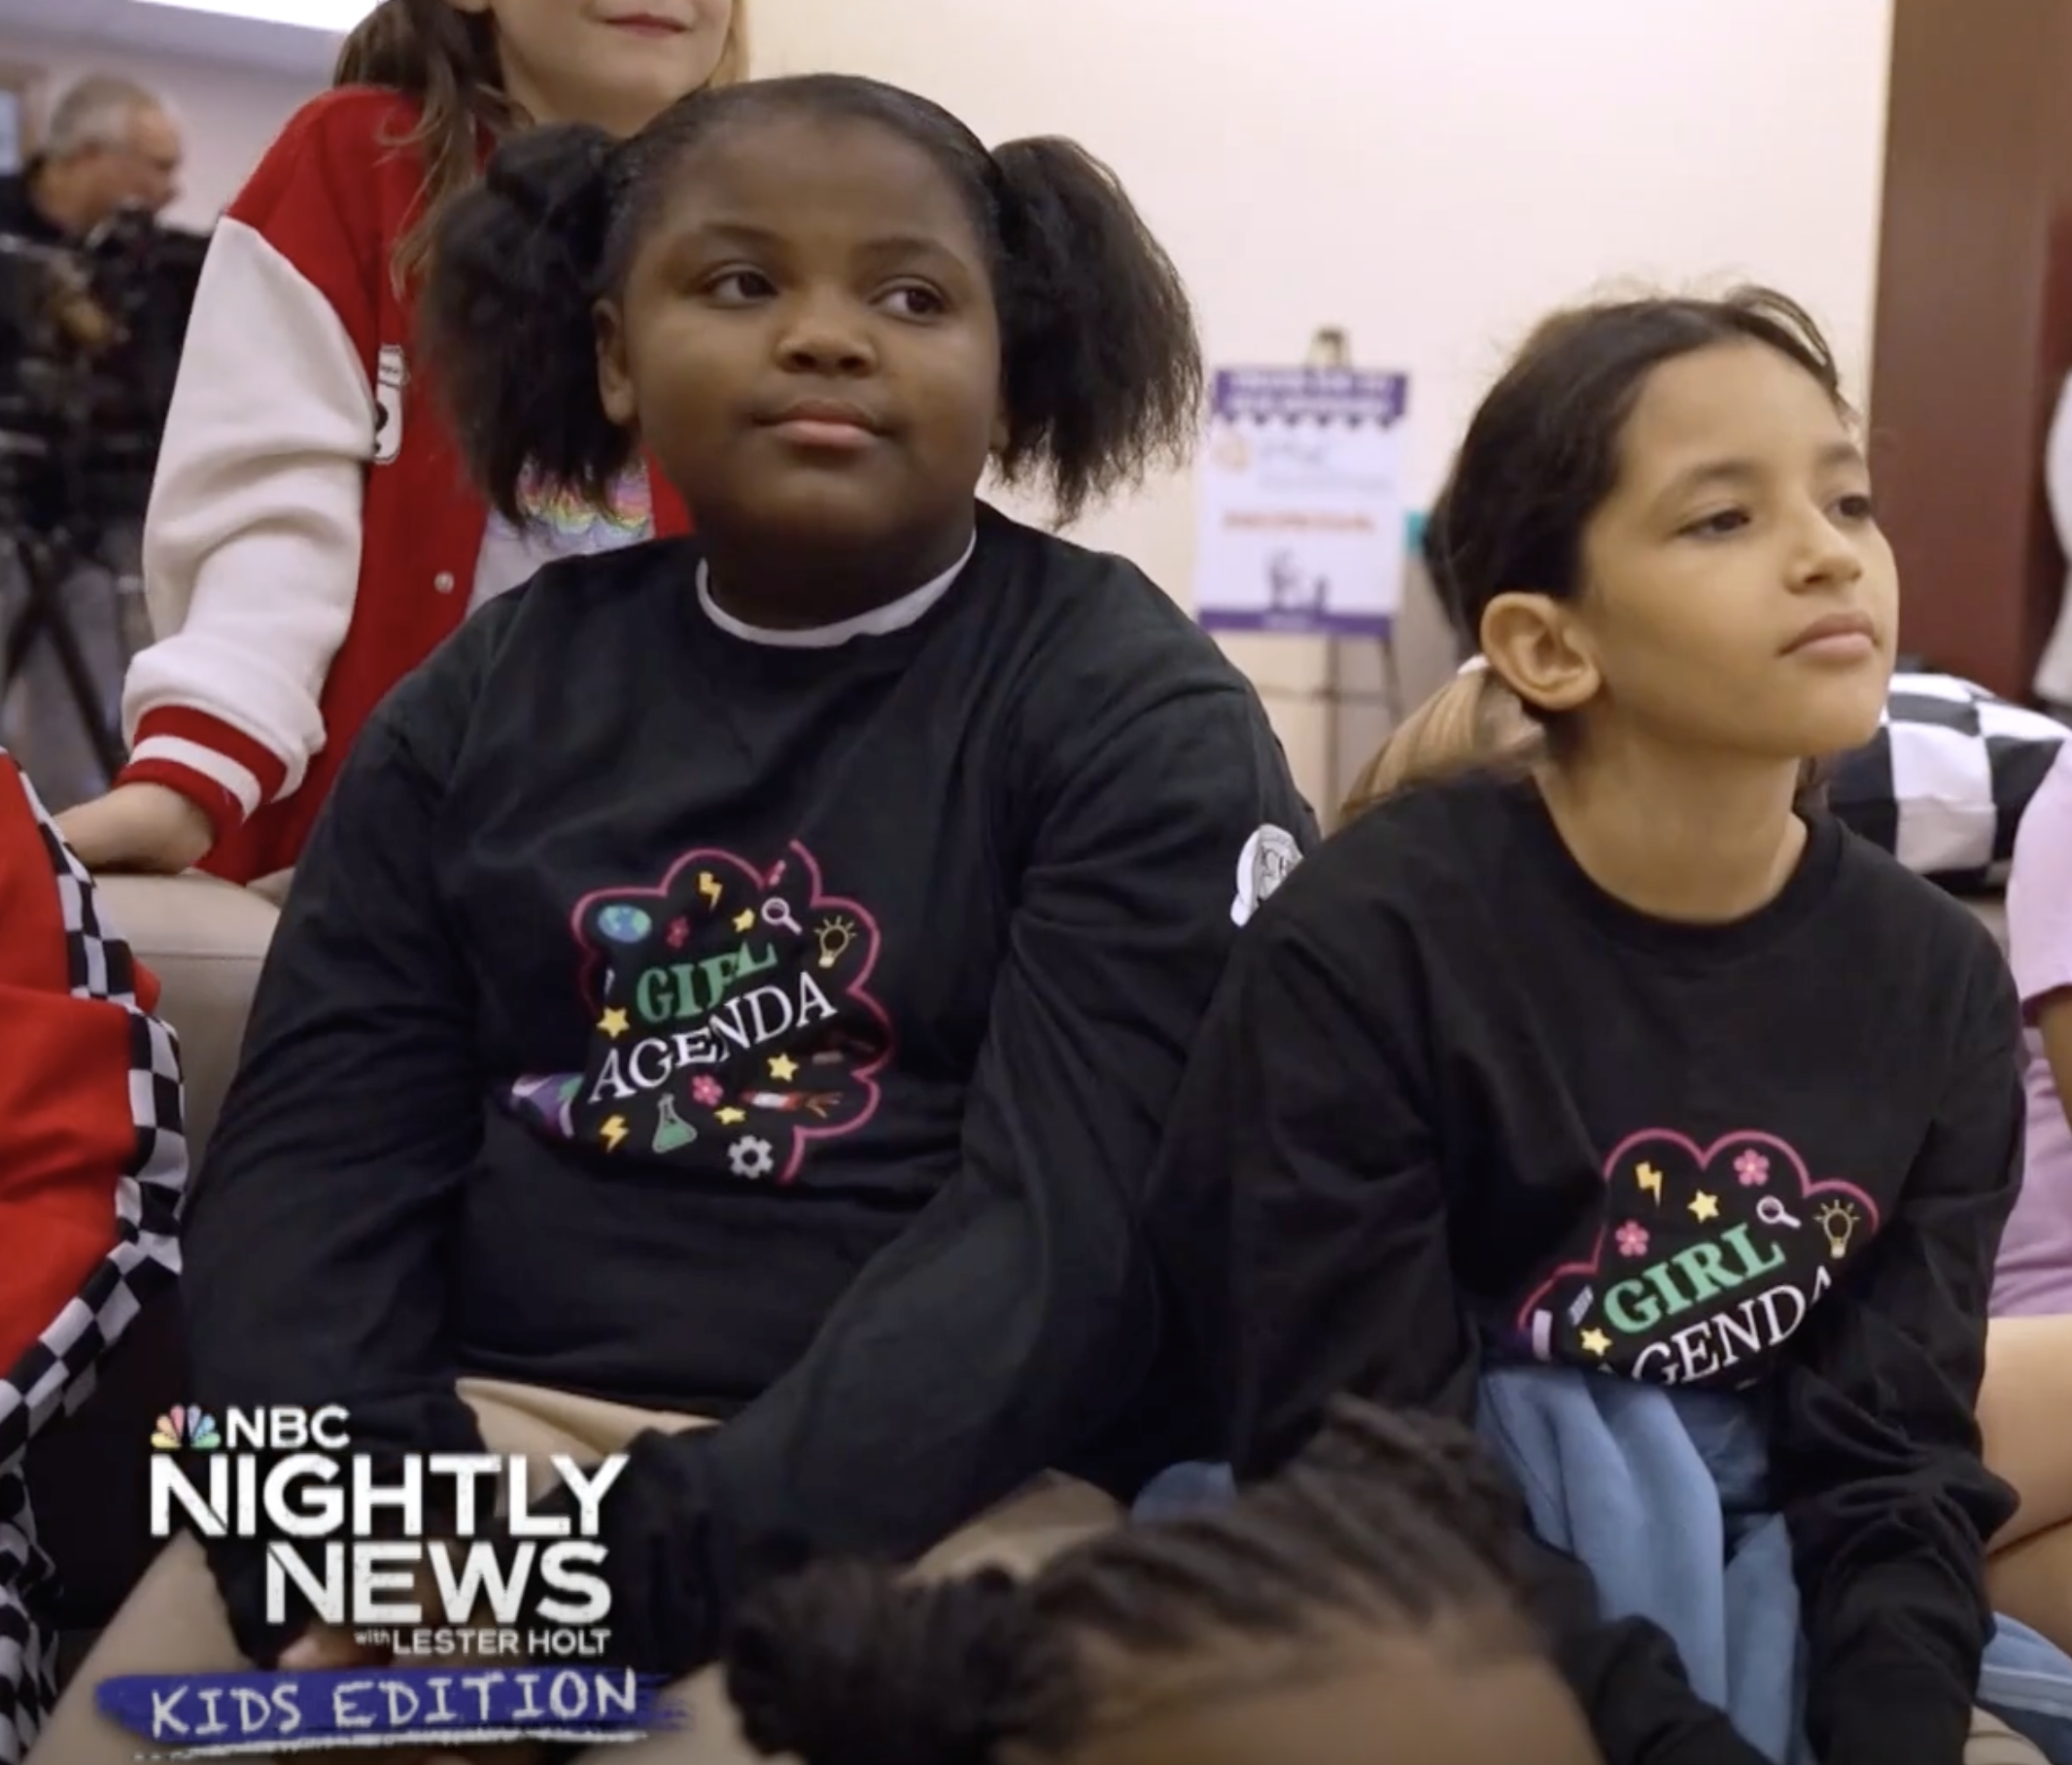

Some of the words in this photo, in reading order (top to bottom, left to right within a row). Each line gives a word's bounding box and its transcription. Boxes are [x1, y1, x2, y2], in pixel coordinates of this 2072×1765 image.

[587, 970, 838, 1104] AGENDA
[1598, 1265, 1832, 1386] GEND
[1604, 1222, 1786, 1333] GIRL
